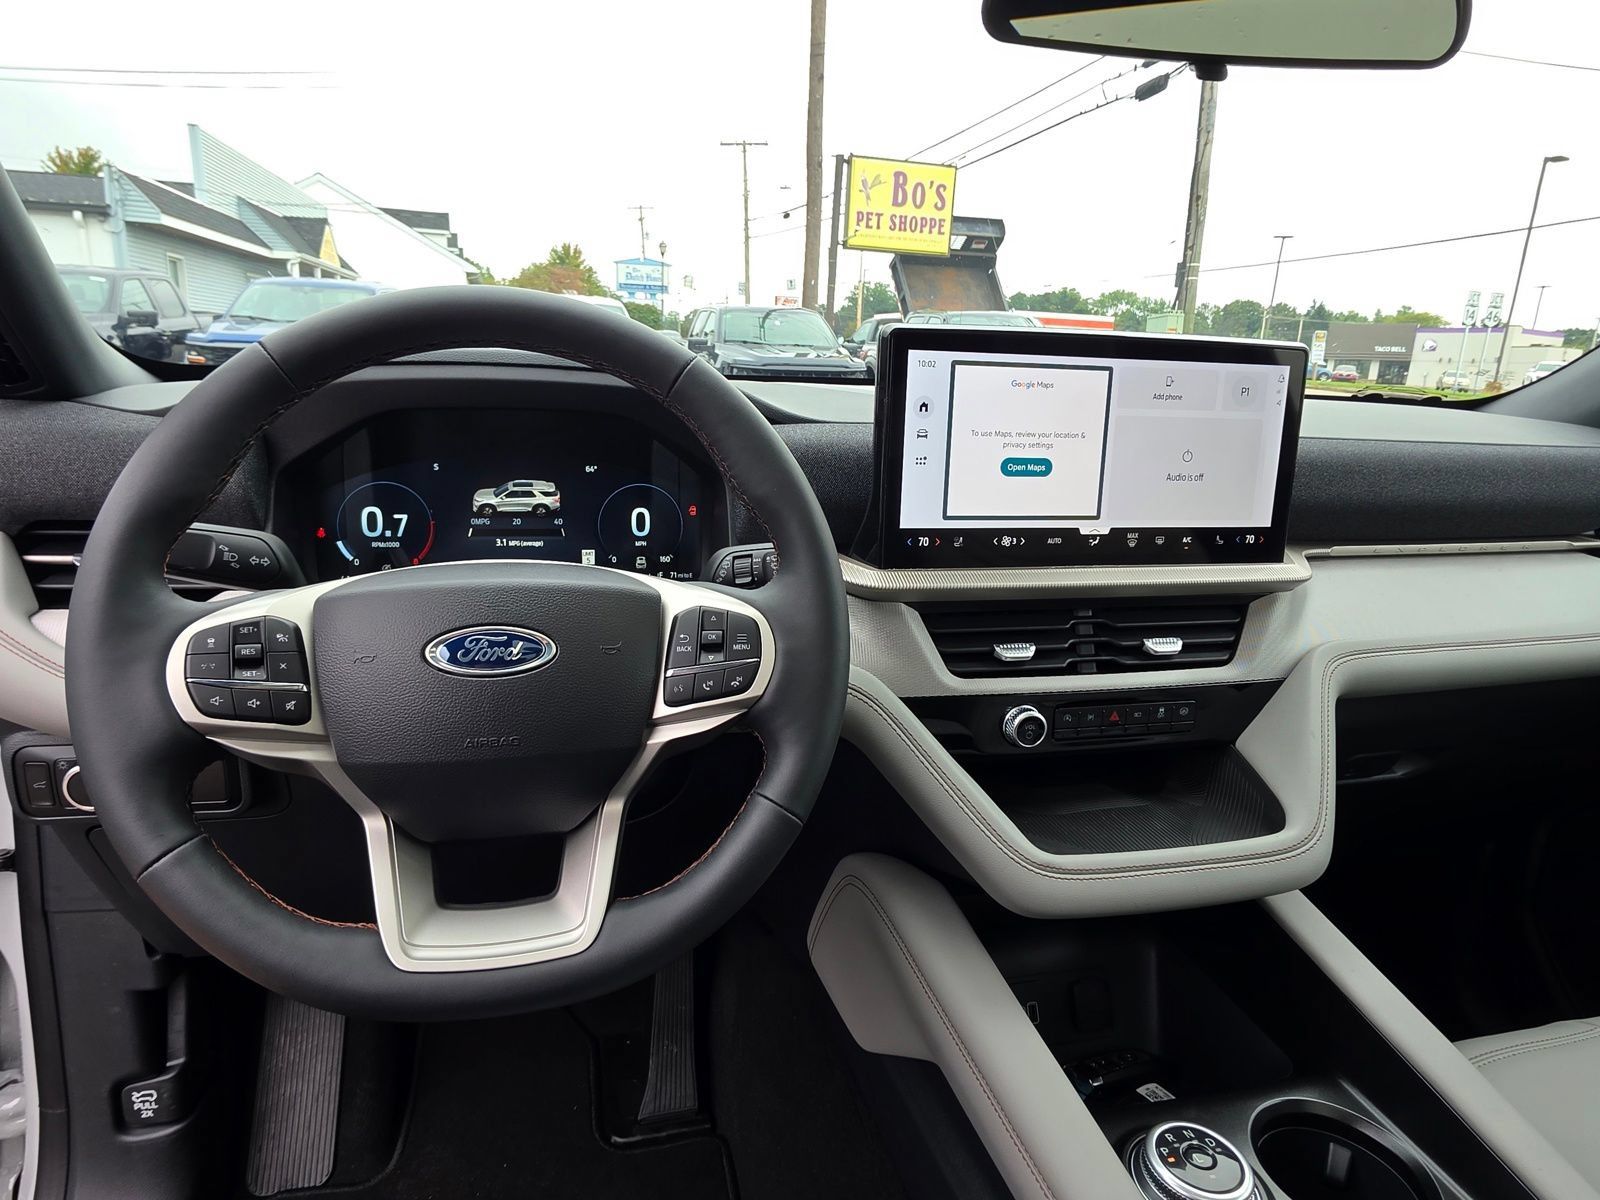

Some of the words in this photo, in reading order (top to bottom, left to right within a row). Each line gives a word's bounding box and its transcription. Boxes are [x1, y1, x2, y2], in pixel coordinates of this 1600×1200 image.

[856, 211, 883, 230] PET
[889, 214, 945, 235] SHOPPE
[1466, 310, 1475, 321] 14
[1486, 311, 1499, 322] 46
[918, 360, 937, 368] 10:02
[1011, 379, 1036, 390] Google
[1037, 381, 1054, 389] Maps
[1240, 387, 1250, 396] P1
[995, 430, 1013, 438] Maps,
[1054, 431, 1079, 439] location
[1028, 442, 1054, 450] settings
[1007, 463, 1026, 472] Open
[1027, 464, 1046, 472] Maps
[1166, 473, 1187, 482] Audio
[1188, 473, 1193, 481] is
[1194, 473, 1204, 482] off
[361, 506, 408, 538] 0.7
[512, 518, 521, 526] 20
[554, 518, 563, 526] 40
[631, 507, 651, 537] 0
[496, 538, 507, 547] 3.1
[521, 540, 544, 548] (average)
[918, 537, 929, 547] 70
[1047, 537, 1062, 545] AUTO
[1245, 535, 1255, 544] 70
[354, 558, 360, 566] 0
[670, 571, 677, 579] 71
[457, 635, 524, 662] Ford
[464, 736, 520, 748] AIRBAG
[133, 1102, 159, 1110] PULL
[1164, 1133, 1177, 1142] R
[1182, 1129, 1195, 1138] N
[1205, 1138, 1216, 1147] D
[1160, 1147, 1169, 1156] P
